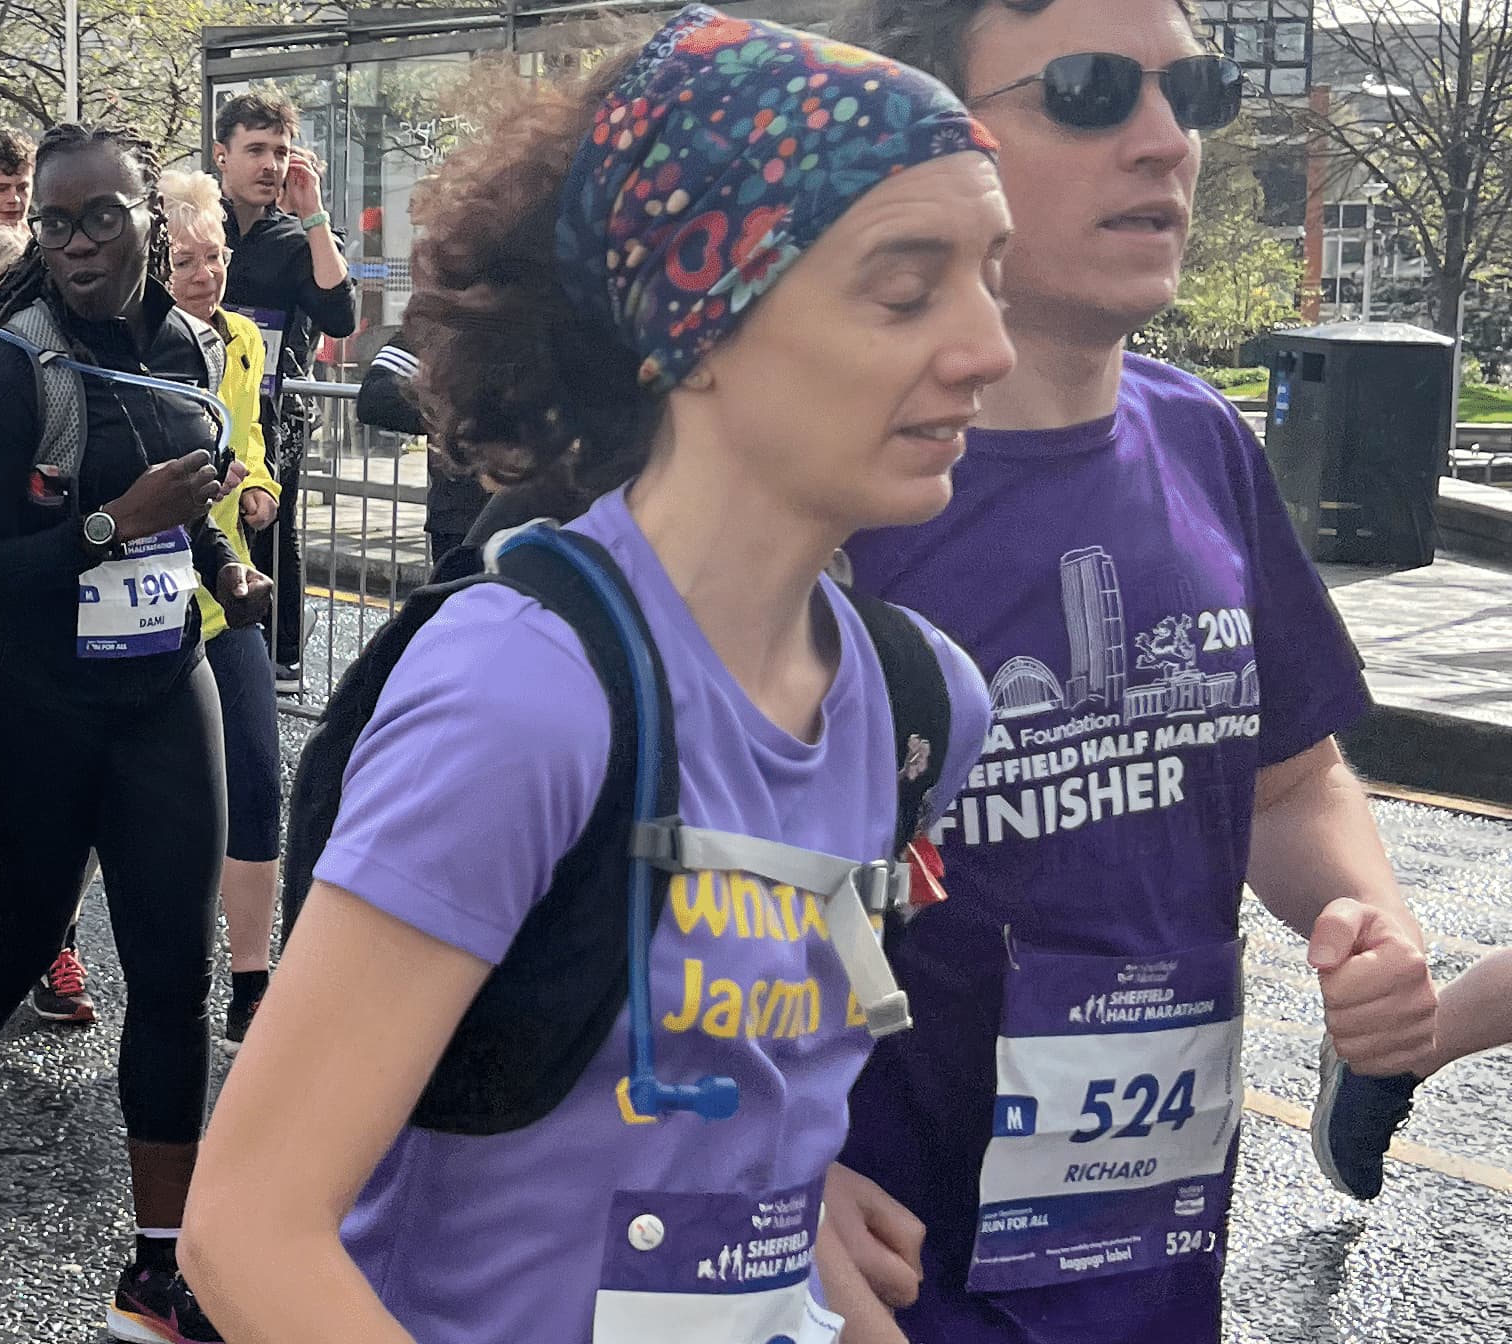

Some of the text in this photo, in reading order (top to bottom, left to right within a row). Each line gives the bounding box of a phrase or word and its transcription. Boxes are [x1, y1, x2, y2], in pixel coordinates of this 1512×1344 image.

[139, 615, 165, 628] DAMI
[1021, 713, 1121, 748] Foundation
[961, 746, 1078, 788] EFFIELD
[1081, 730, 1149, 766] HALF
[1109, 988, 1175, 1005] SHEFFIELD
[1106, 999, 1215, 1022] HALF MARATHON
[1006, 1106, 1023, 1130] M
[1068, 1069, 1196, 1143] 524
[1064, 1158, 1157, 1183] RICHARD
[1006, 1216, 1028, 1230] FOR
[1029, 1213, 1049, 1227] ALL
[748, 1229, 808, 1258] SHEFFIELD
[1166, 1230, 1203, 1256] 524
[744, 1258, 783, 1279] HALF
